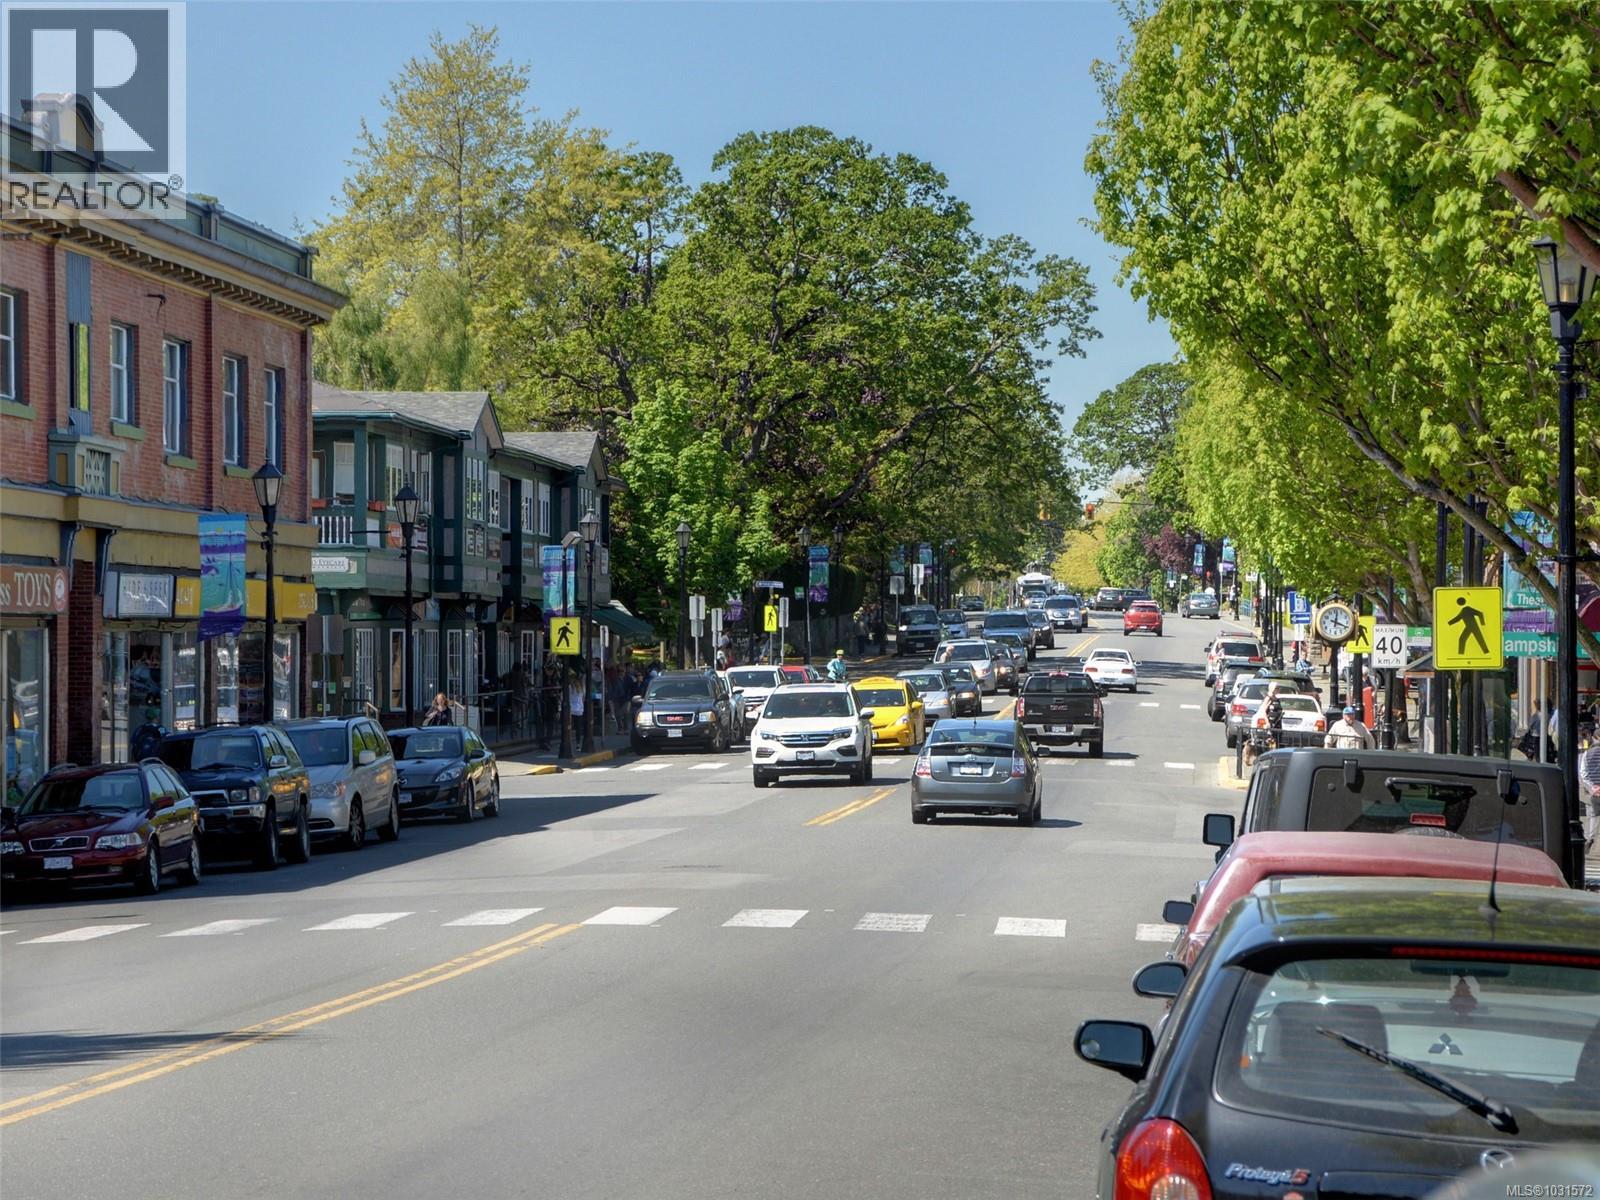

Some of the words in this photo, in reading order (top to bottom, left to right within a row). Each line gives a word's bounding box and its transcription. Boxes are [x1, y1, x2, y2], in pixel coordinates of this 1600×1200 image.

[14, 571, 51, 608] TOYS
[1375, 636, 1402, 654] 40
[1504, 637, 1556, 656] ampsh
